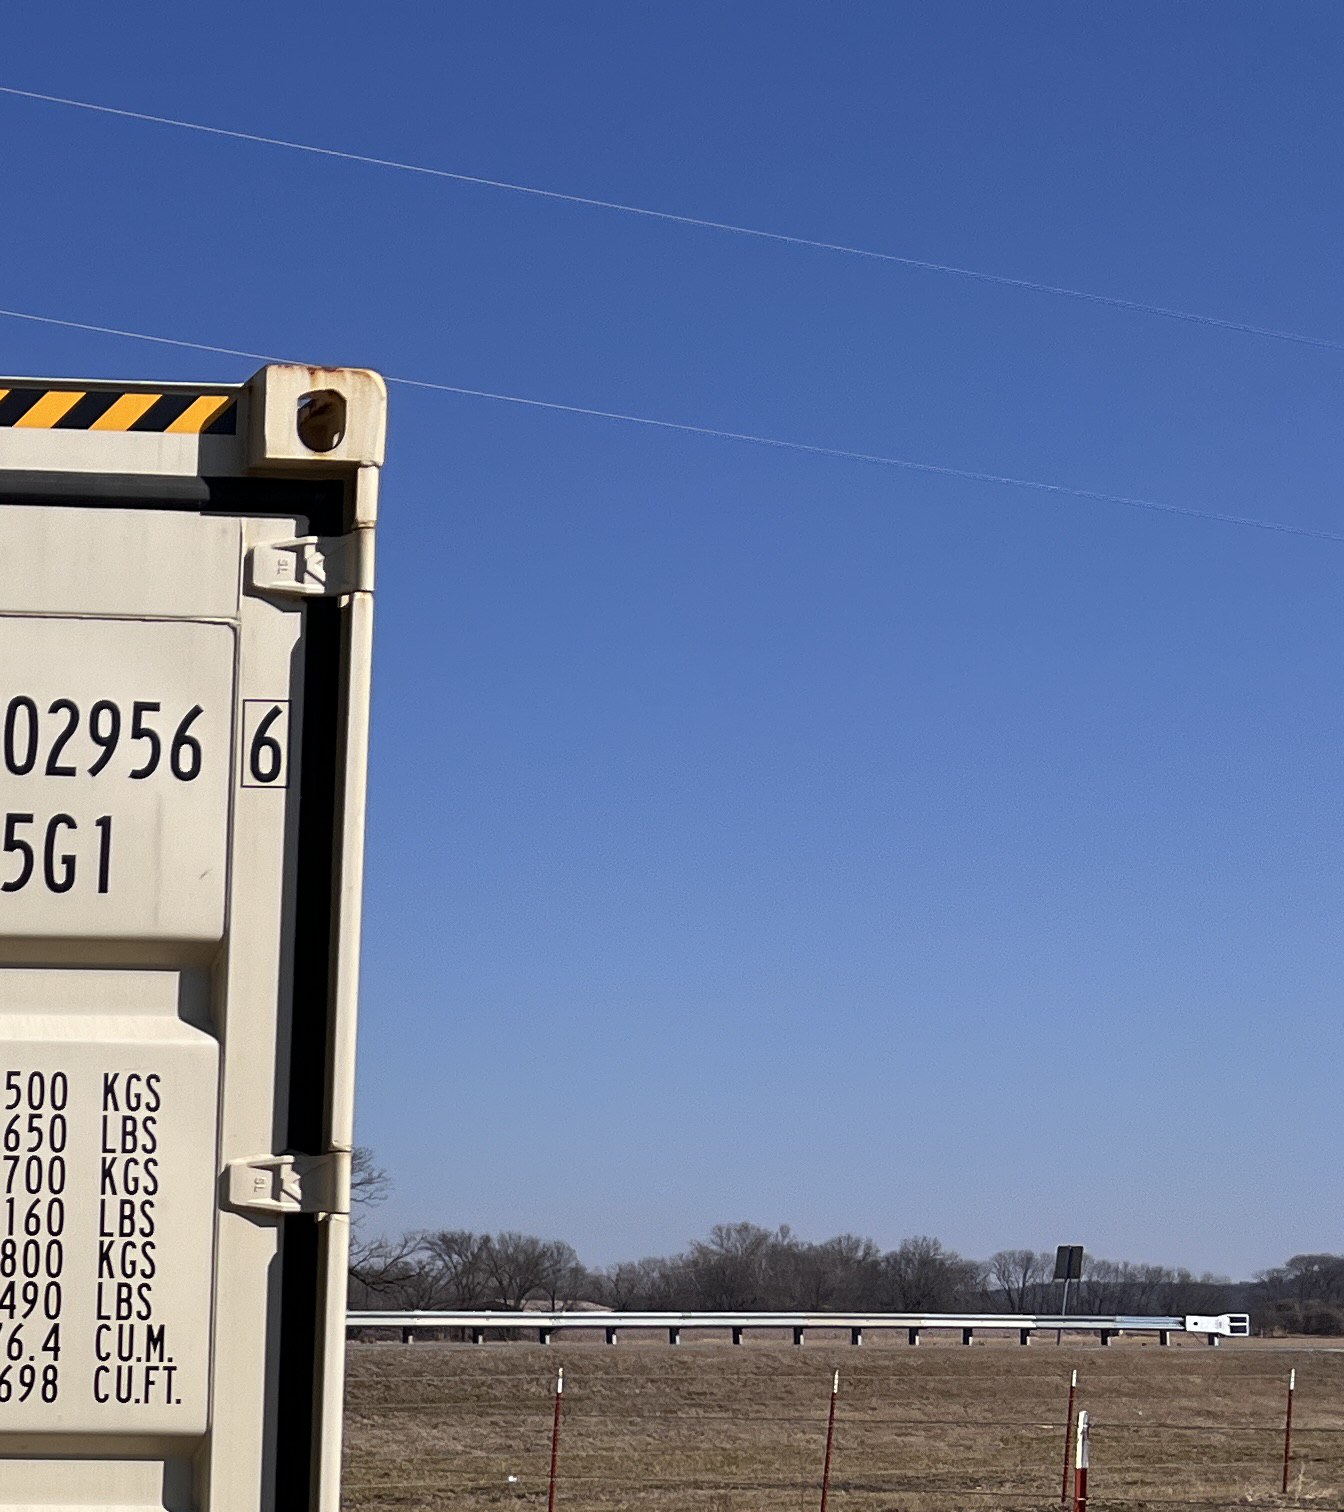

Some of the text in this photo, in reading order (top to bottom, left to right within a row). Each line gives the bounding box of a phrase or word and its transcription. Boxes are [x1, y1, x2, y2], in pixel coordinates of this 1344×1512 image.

[250, 706, 282, 783] 6
[103, 1073, 160, 1112] KGS
[102, 1115, 156, 1154] LBS
[101, 1157, 158, 1195] KGS
[100, 1199, 154, 1237] LBS
[98, 1240, 155, 1279] KGS
[97, 1282, 151, 1320] LBS
[96, 1324, 172, 1362] CU.M.
[94, 1365, 181, 1404] CU.FT.
